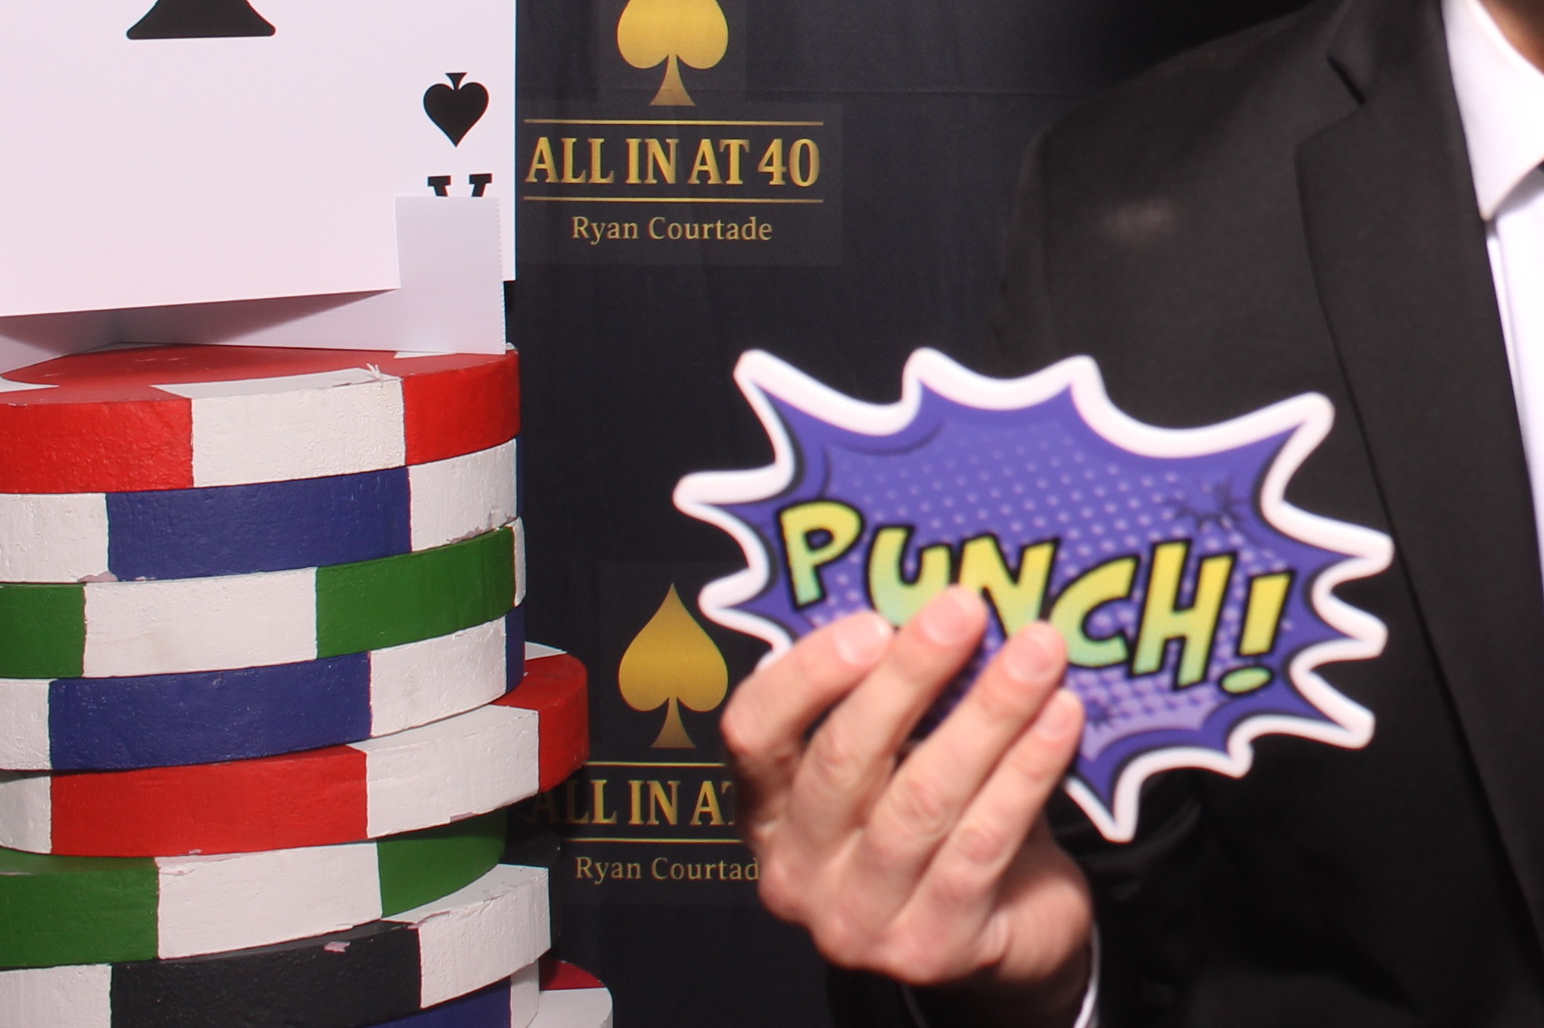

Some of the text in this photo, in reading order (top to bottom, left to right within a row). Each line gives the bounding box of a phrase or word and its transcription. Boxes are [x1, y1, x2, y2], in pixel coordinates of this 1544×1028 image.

[525, 136, 614, 185] ALL
[625, 137, 680, 185] IN
[688, 138, 750, 186] AT
[758, 137, 820, 188] 40
[571, 215, 773, 246] Ryan Courtade
[779, 500, 1293, 694] PUNCH!
[628, 780, 681, 825] IN
[575, 856, 761, 884] Ryan Courtad
